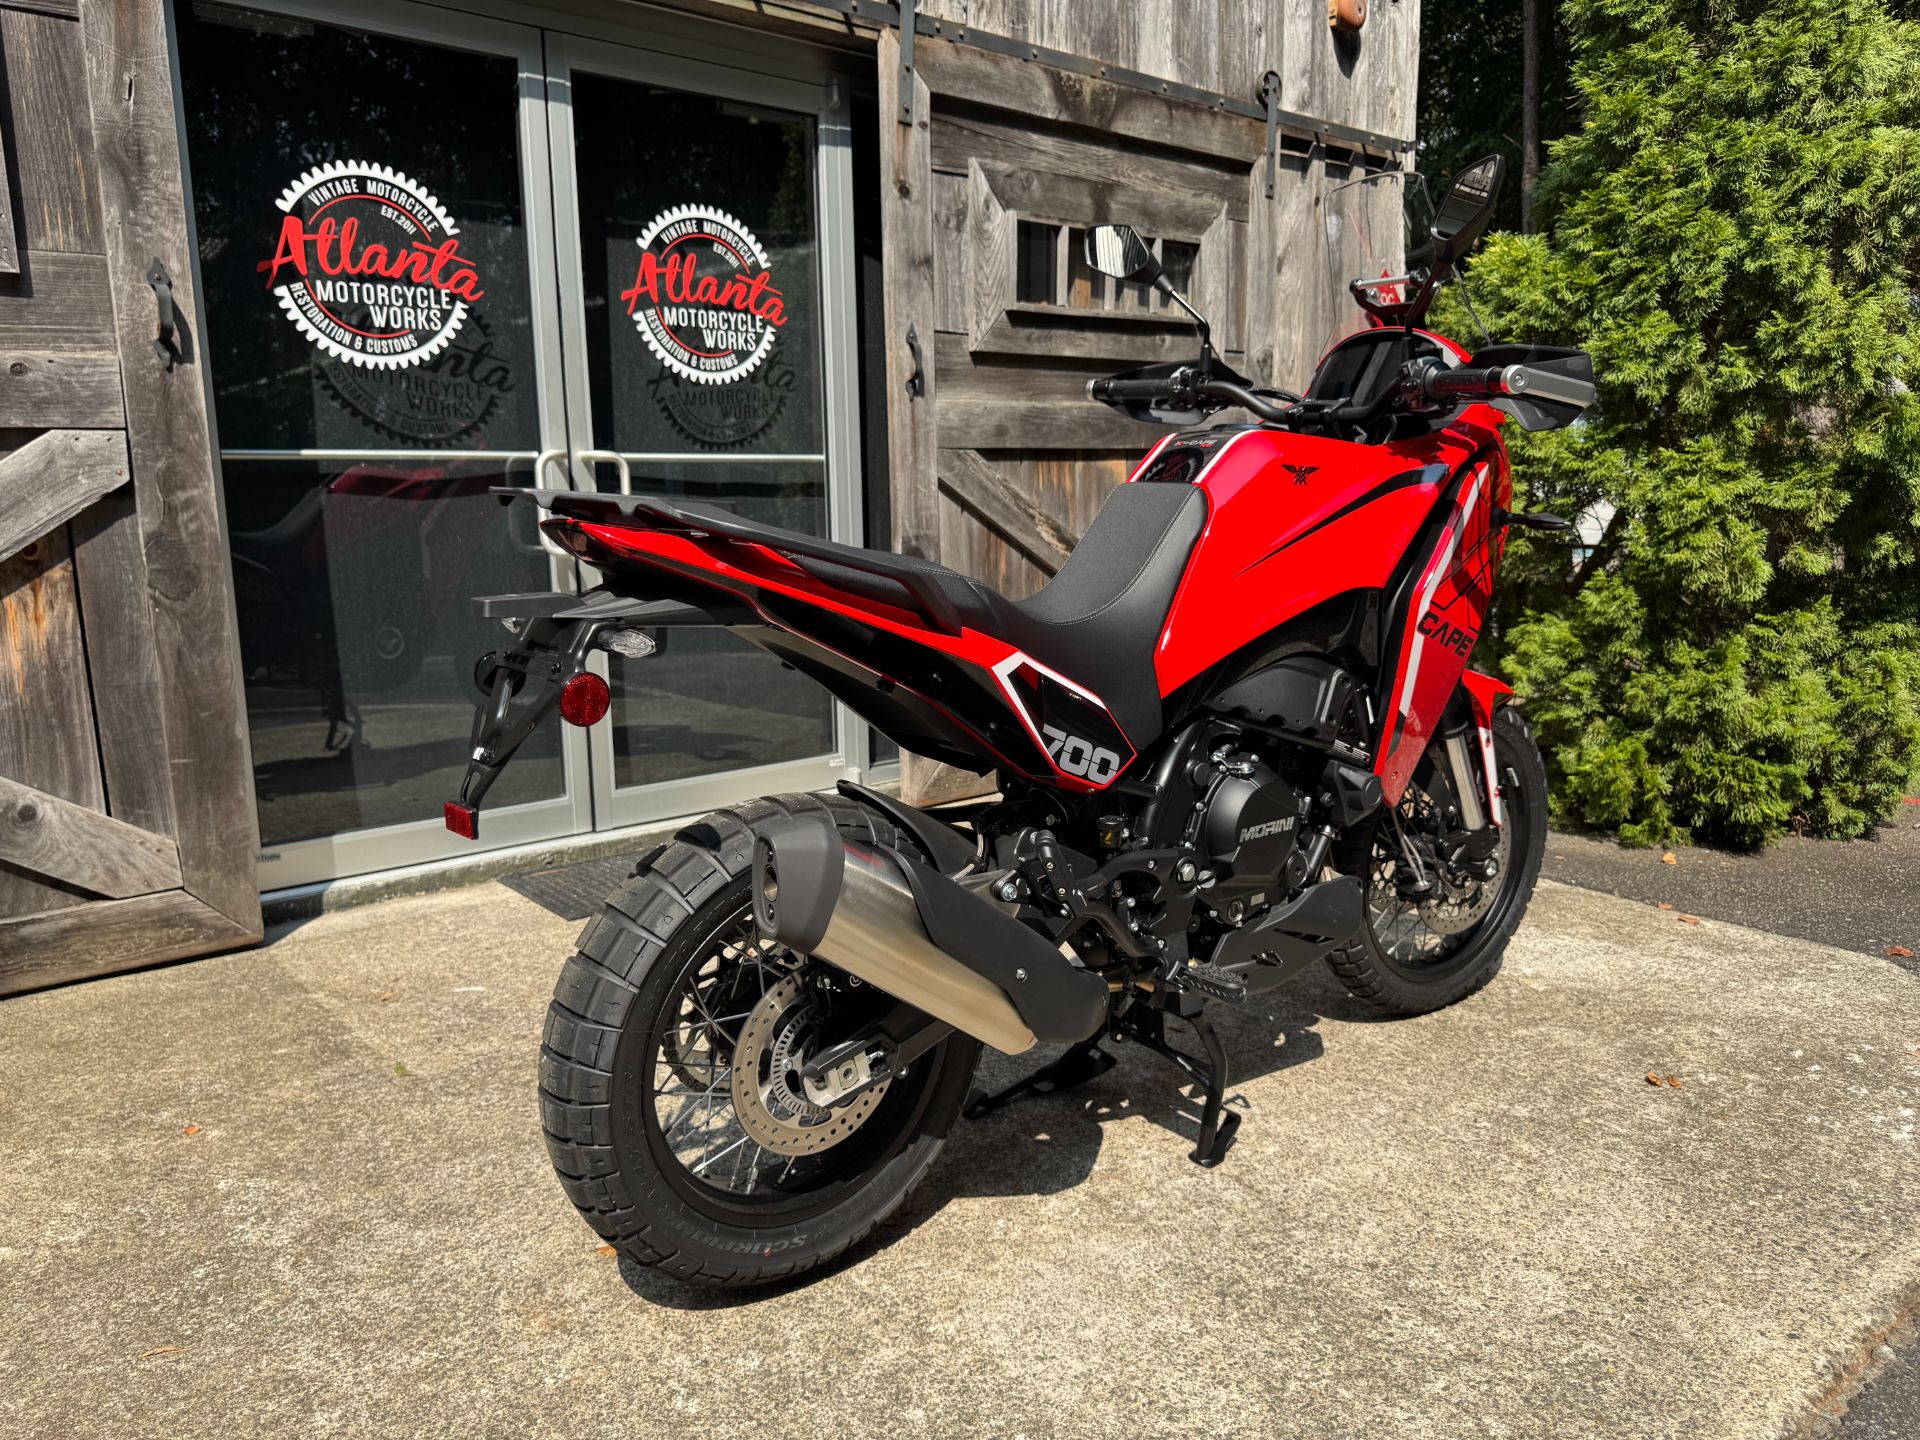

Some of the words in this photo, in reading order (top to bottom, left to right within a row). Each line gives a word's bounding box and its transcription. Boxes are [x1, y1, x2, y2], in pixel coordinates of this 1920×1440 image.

[308, 178, 359, 207] VINTAGE
[366, 179, 439, 233] MOTORCYCLE
[381, 205, 418, 235] EST.2011
[256, 215, 484, 302] Atlanta
[660, 219, 699, 245] VINTAGE
[703, 220, 757, 266] MOTORCYCLE
[712, 240, 740, 269] EST.2011
[315, 279, 452, 311] MOTORCYCLE
[621, 252, 789, 326] Atlanta
[289, 281, 351, 346] RESTORATION
[354, 334, 363, 350] &
[366, 334, 418, 354] CUSTOMS
[369, 304, 442, 331] WORKS
[644, 308, 691, 364] RESTORATION
[699, 353, 739, 371] CUSTOMS
[663, 306, 764, 334] MOTORCYCLE
[702, 328, 757, 352] WORKS
[1417, 609, 1475, 658] CAPE
[1042, 723, 1121, 785] 700
[1239, 815, 1295, 843] MORINI
